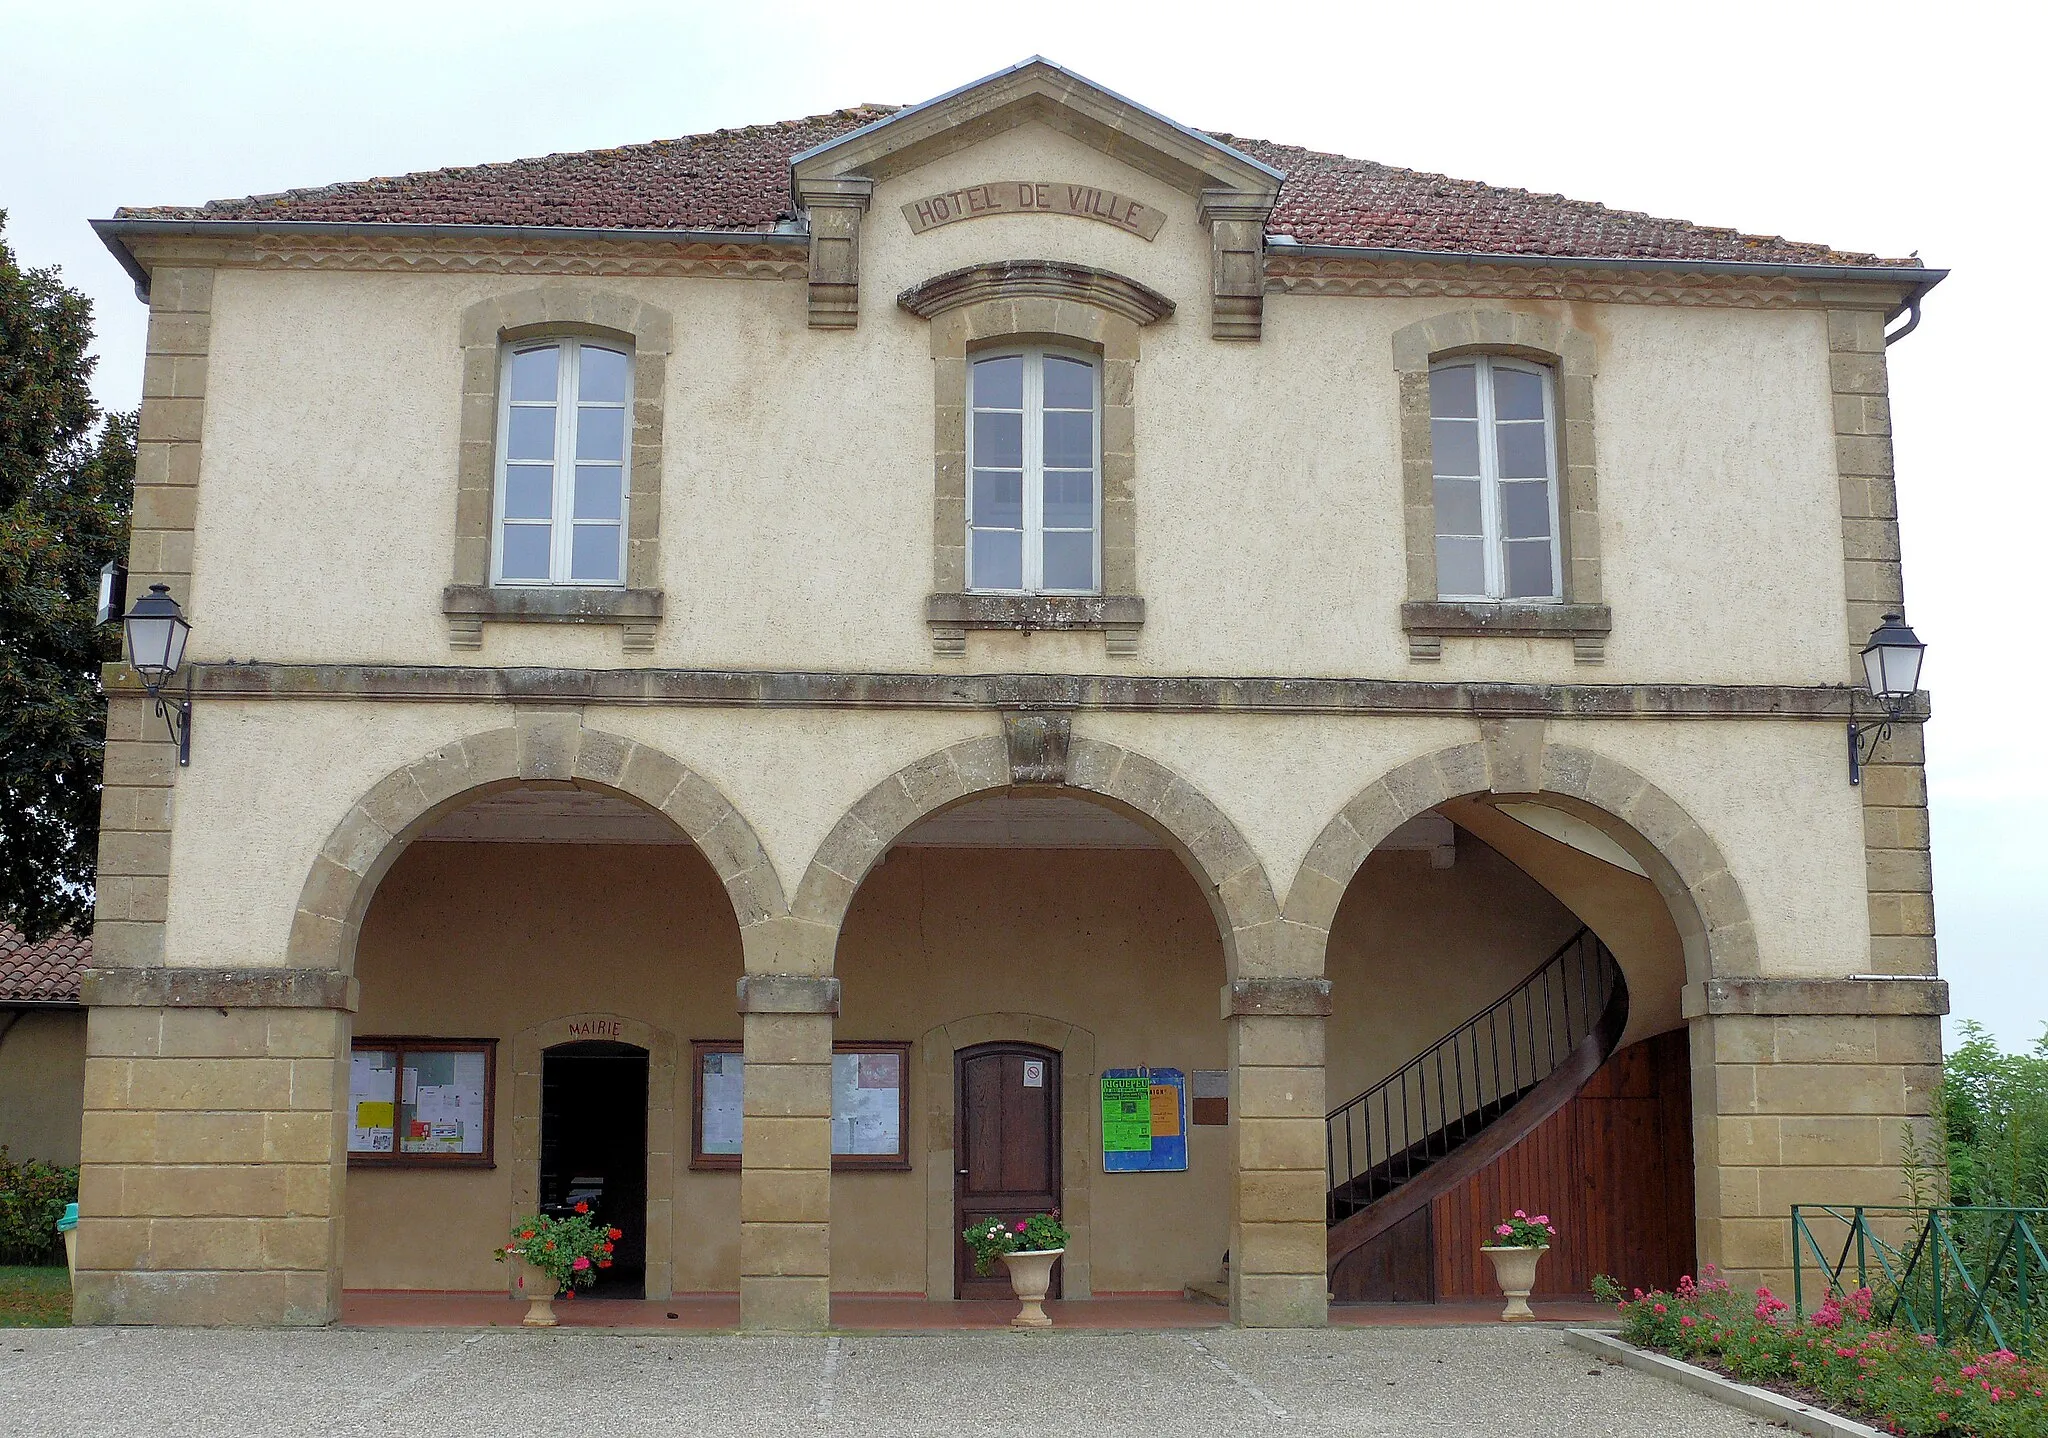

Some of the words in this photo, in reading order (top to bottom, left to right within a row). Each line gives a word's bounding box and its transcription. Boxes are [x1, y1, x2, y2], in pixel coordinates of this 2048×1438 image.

[915, 186, 1001, 227] HOTEL
[1018, 183, 1050, 208] DE
[1067, 186, 1144, 228] VILLE
[569, 1020, 621, 1036] MAIRIE
